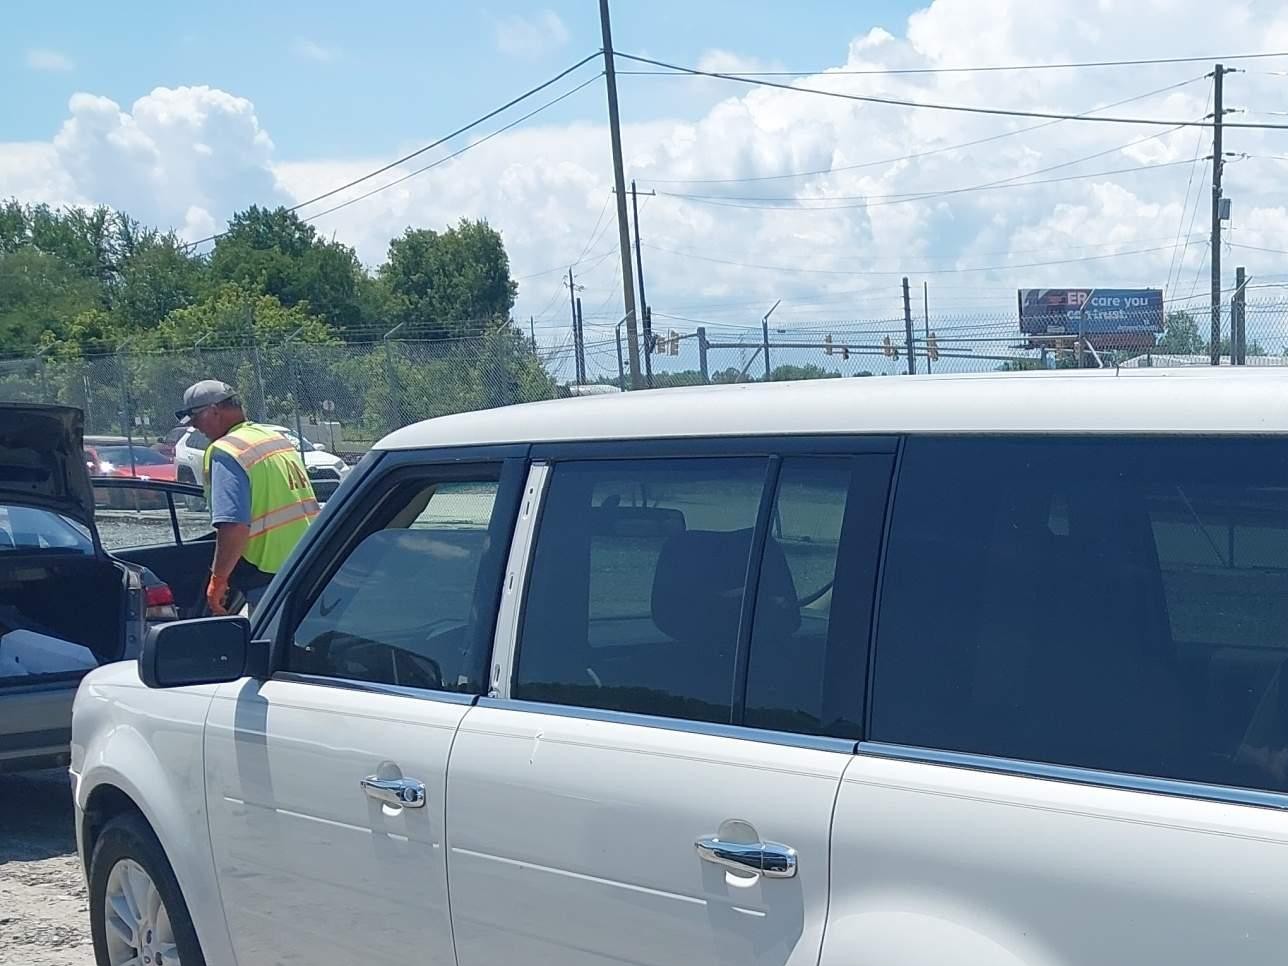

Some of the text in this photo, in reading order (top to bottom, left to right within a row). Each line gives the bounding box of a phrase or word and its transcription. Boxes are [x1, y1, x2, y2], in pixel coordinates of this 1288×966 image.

[1067, 292, 1148, 309] ER care you
